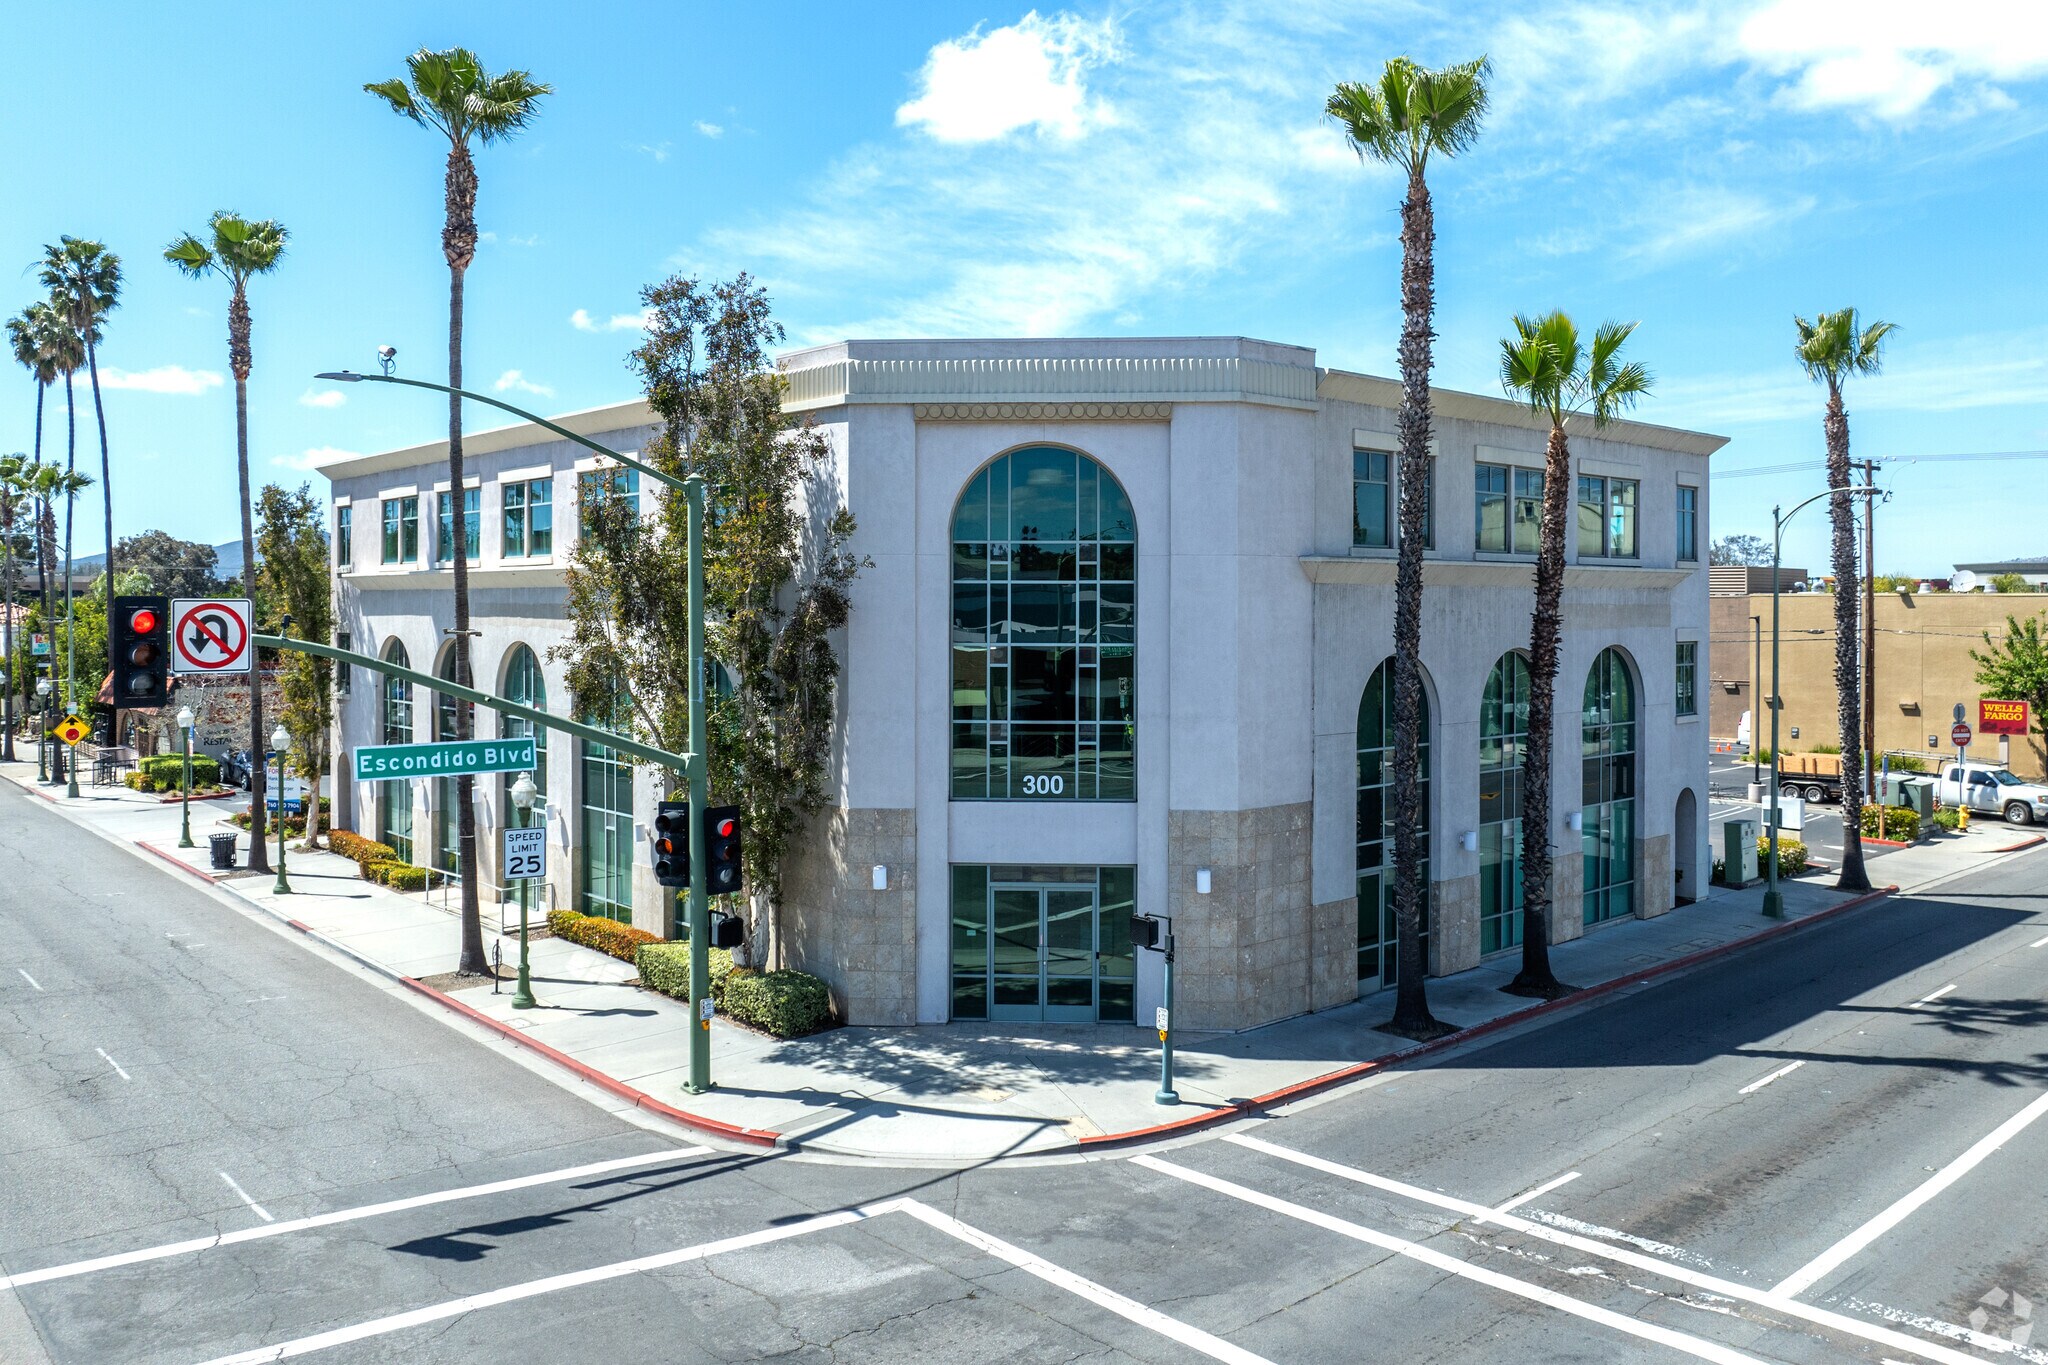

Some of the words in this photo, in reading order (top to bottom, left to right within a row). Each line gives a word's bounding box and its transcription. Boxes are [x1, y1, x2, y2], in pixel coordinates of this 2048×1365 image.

[1983, 704, 2023, 712] WELLS
[1984, 711, 2023, 721] FARGO
[360, 751, 477, 773] Escondido
[484, 746, 532, 765] Blvd
[1022, 774, 1064, 795] 300
[508, 832, 542, 842] SPEED
[511, 843, 539, 853] LIMIT
[509, 855, 541, 875] 25
